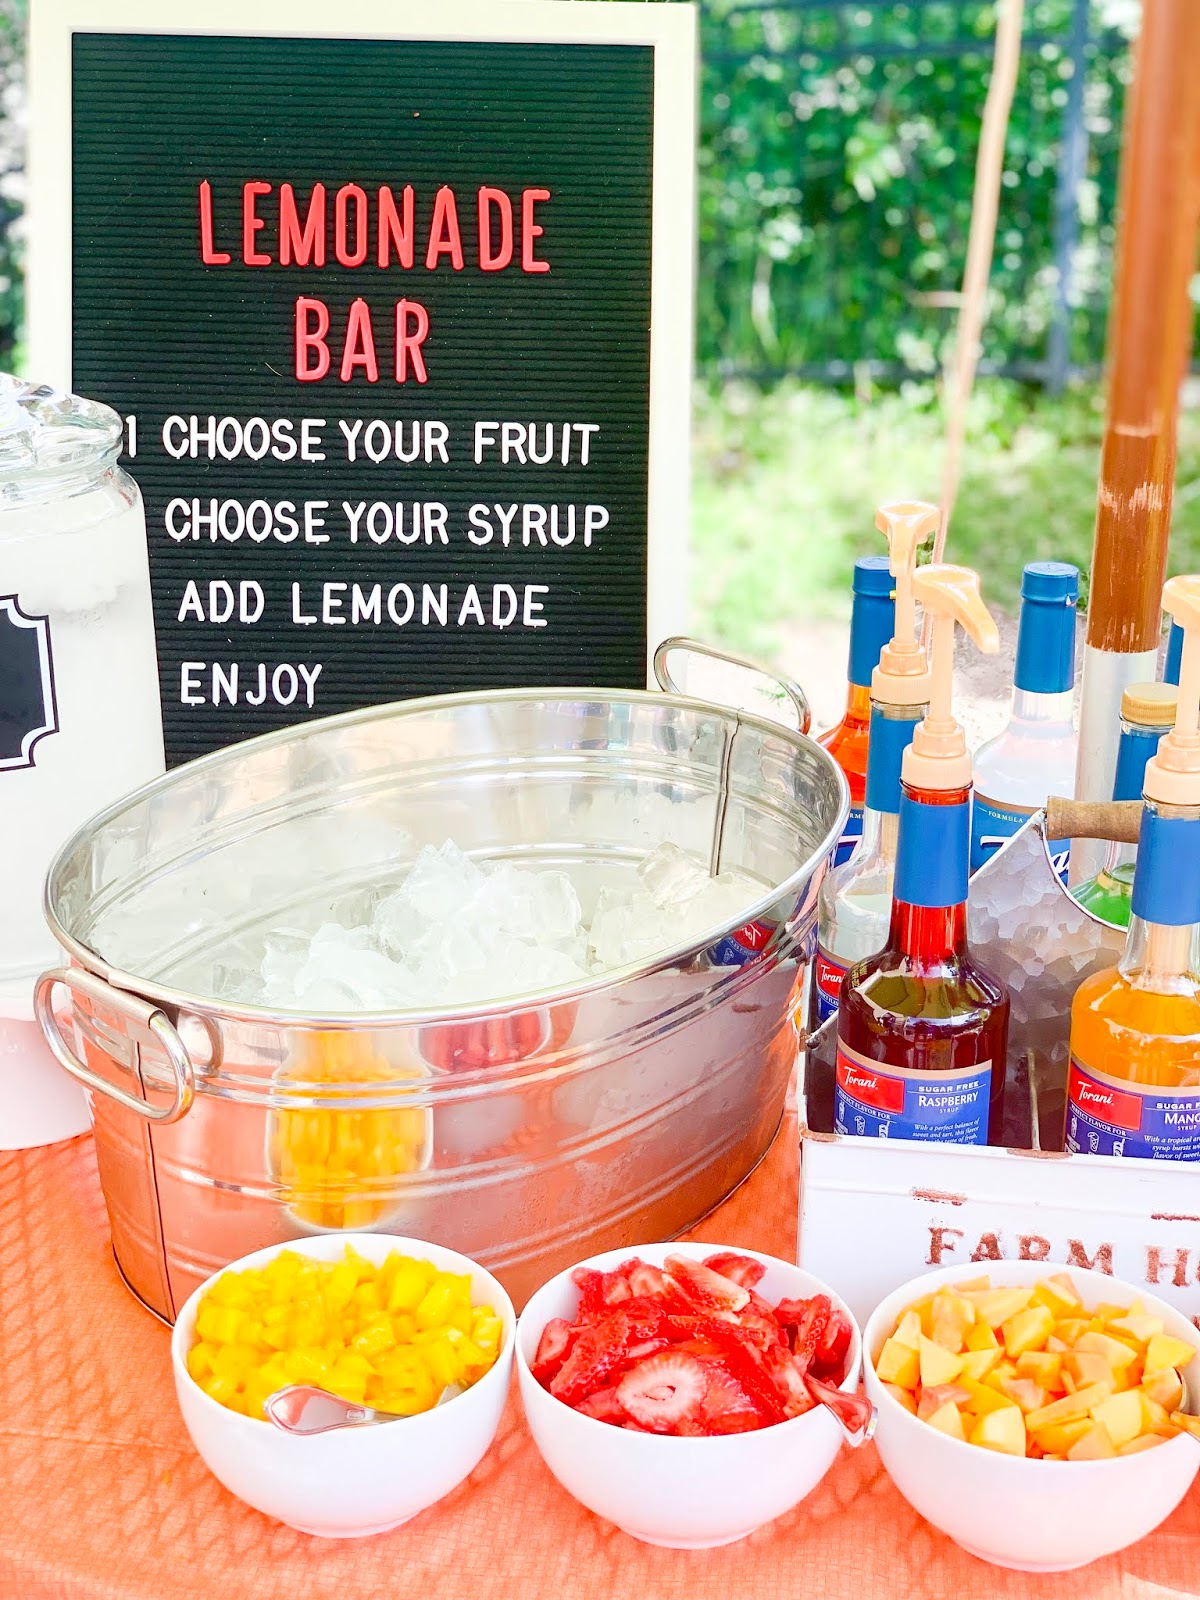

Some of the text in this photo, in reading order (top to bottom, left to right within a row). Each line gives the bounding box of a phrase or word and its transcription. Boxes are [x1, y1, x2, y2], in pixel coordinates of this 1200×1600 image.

[199, 179, 552, 274] LEMONADE
[293, 296, 429, 384] BAR
[162, 414, 327, 463] CHOOSE
[338, 418, 450, 464] YOUR
[473, 421, 600, 467] FRUIT
[164, 497, 610, 548] CHOOSE YOUR SYRUP
[177, 579, 550, 630] ADD LEMONADE
[179, 661, 324, 708] ENJOY
[987, 810, 1024, 824] FORMULA
[843, 1065, 877, 1089] Torani
[918, 1081, 979, 1093] SUGAR FREE
[918, 1091, 979, 1108] RASPBERRY
[1077, 1080, 1114, 1104] Torani
[876, 1111, 891, 1121] FOR
[1156, 1102, 1193, 1110] SUGAR
[914, 1123, 929, 1131] With
[973, 1117, 981, 1125] of
[1087, 1117, 1112, 1133] FLAVOR
[1112, 1127, 1127, 1137] FOR
[1144, 1134, 1160, 1143] With
[1167, 1135, 1193, 1145] tropical
[1152, 1151, 1174, 1160] flavor
[1174, 1151, 1183, 1160] of
[924, 1224, 1117, 1277] FARM
